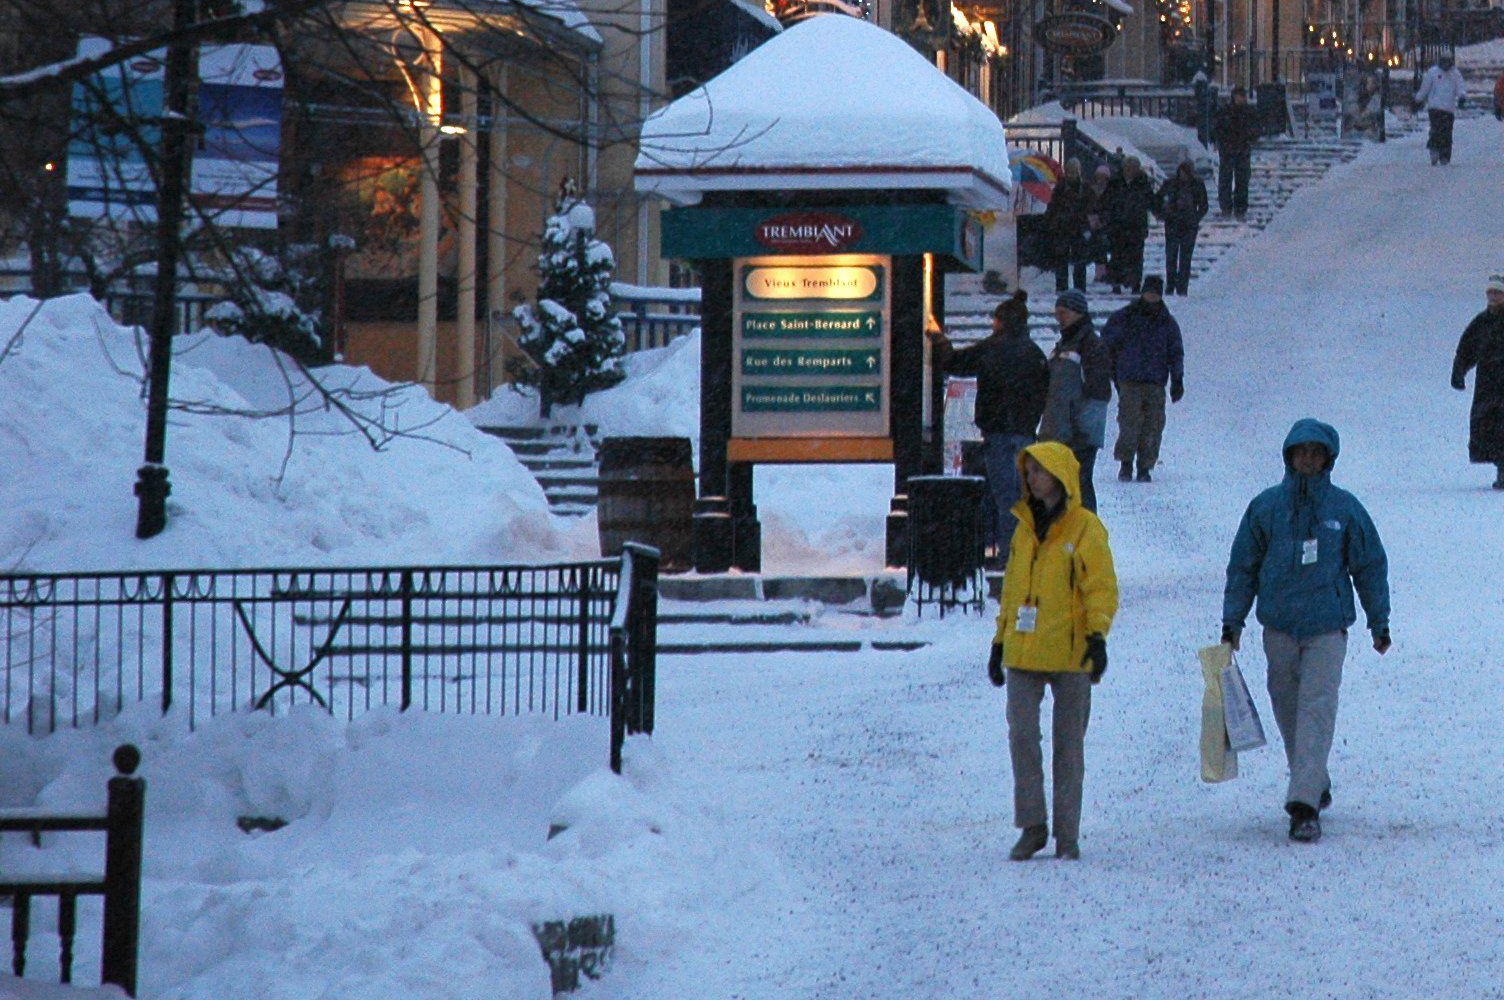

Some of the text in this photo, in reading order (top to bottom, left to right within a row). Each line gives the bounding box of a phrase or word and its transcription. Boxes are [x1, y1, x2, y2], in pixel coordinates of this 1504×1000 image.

[763, 223, 854, 247] TREMBLANT
[764, 278, 796, 288] Vieux
[746, 318, 861, 330] Place Saint-Bernard
[746, 355, 853, 369] Rue des Remparts
[746, 392, 859, 404] Promenade Deslauriers
